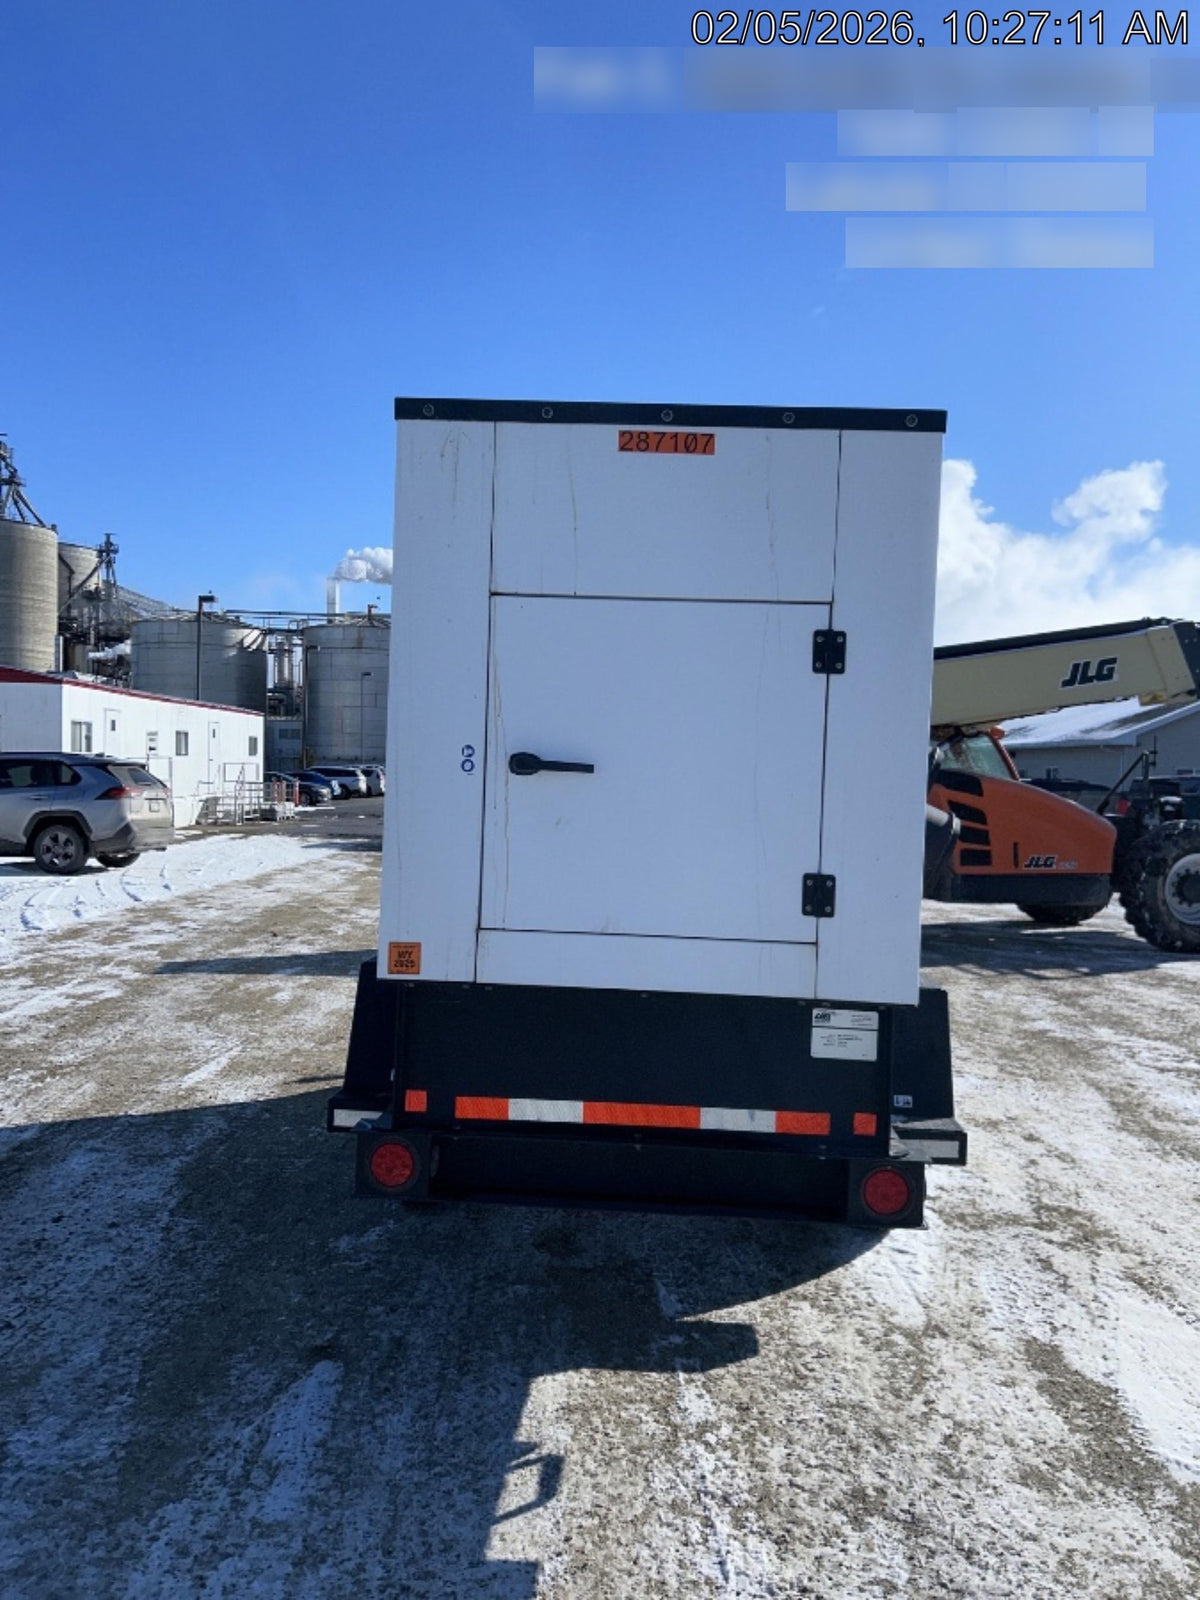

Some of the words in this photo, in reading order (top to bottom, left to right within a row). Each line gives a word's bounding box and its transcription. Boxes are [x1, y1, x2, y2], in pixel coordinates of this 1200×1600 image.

[620, 431, 714, 453] 287107
[1061, 657, 1118, 688] JLG
[1024, 856, 1056, 868] JLG
